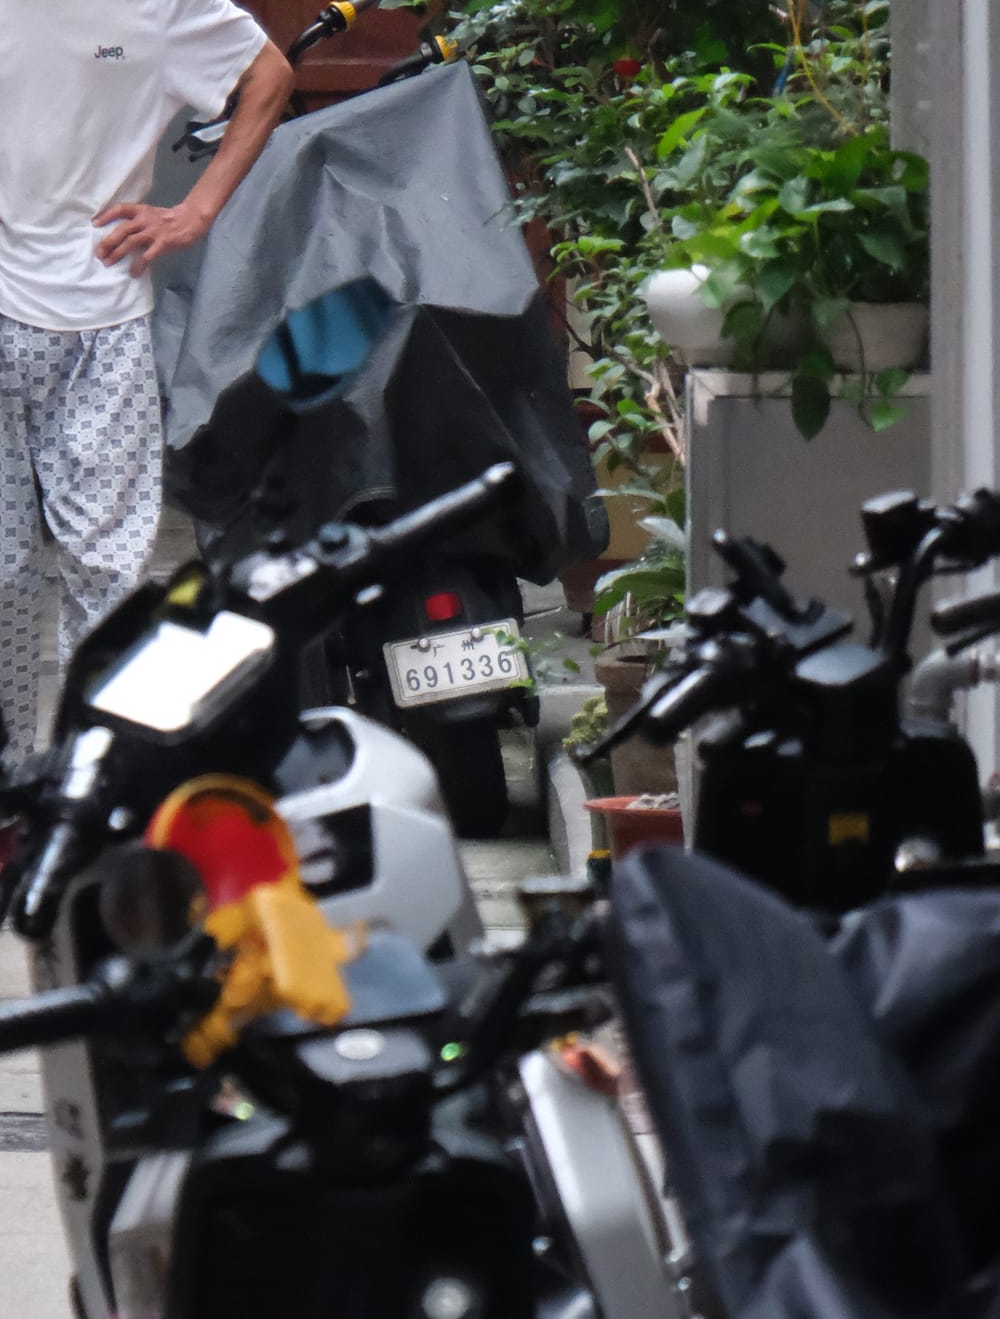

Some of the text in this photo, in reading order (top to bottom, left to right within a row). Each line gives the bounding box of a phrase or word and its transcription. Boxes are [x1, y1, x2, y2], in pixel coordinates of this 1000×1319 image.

[93, 44, 125, 61] Jeep
[432, 639, 476, 659] 广州
[405, 651, 514, 693] 691336
